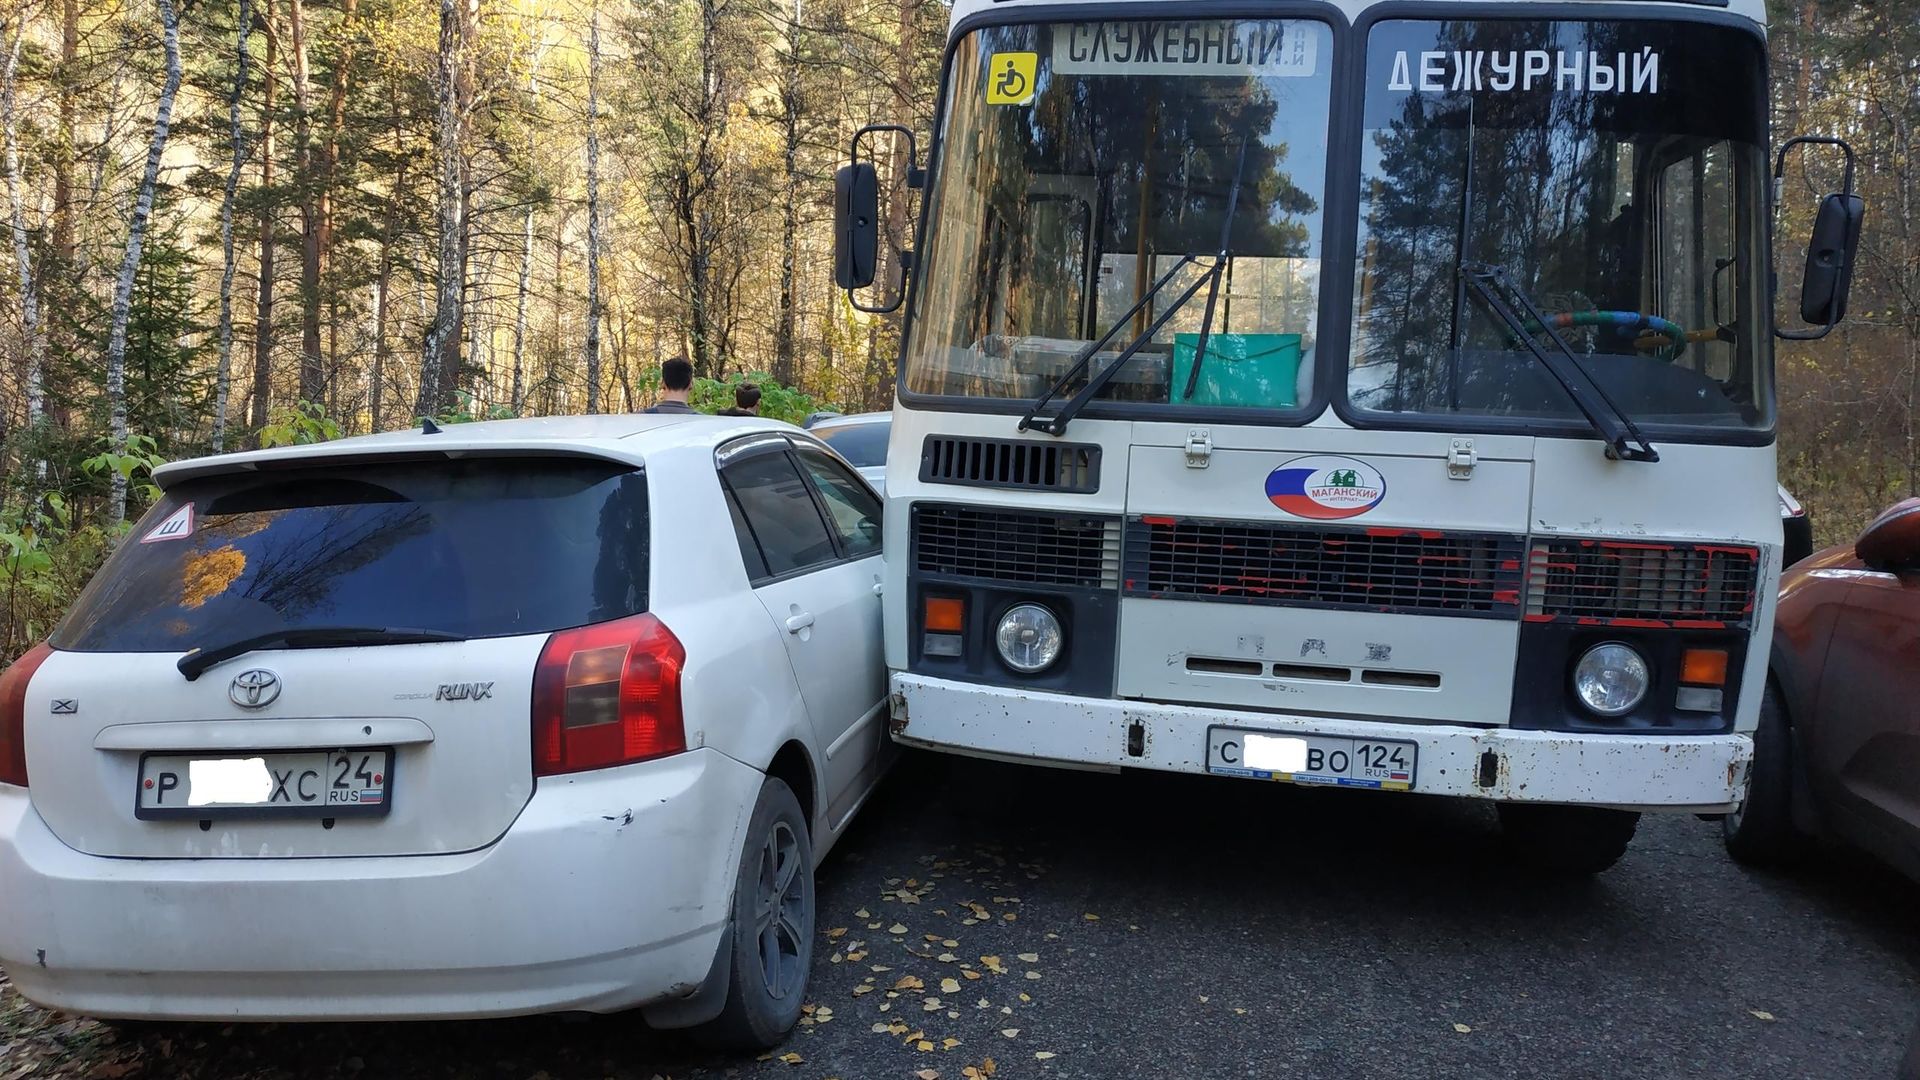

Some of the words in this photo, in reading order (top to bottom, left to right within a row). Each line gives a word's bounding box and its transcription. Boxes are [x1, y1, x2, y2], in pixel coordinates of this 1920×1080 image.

[1388, 46, 1659, 93] ДЕЖУРНЫЙ
[1312, 488, 1377, 499] МАГАНСКИЙ
[435, 682, 495, 701] RUNX
[1357, 744, 1404, 769] 124
[332, 755, 373, 788] 24
[1365, 768, 1390, 778] RUS
[329, 790, 359, 802] RUS
